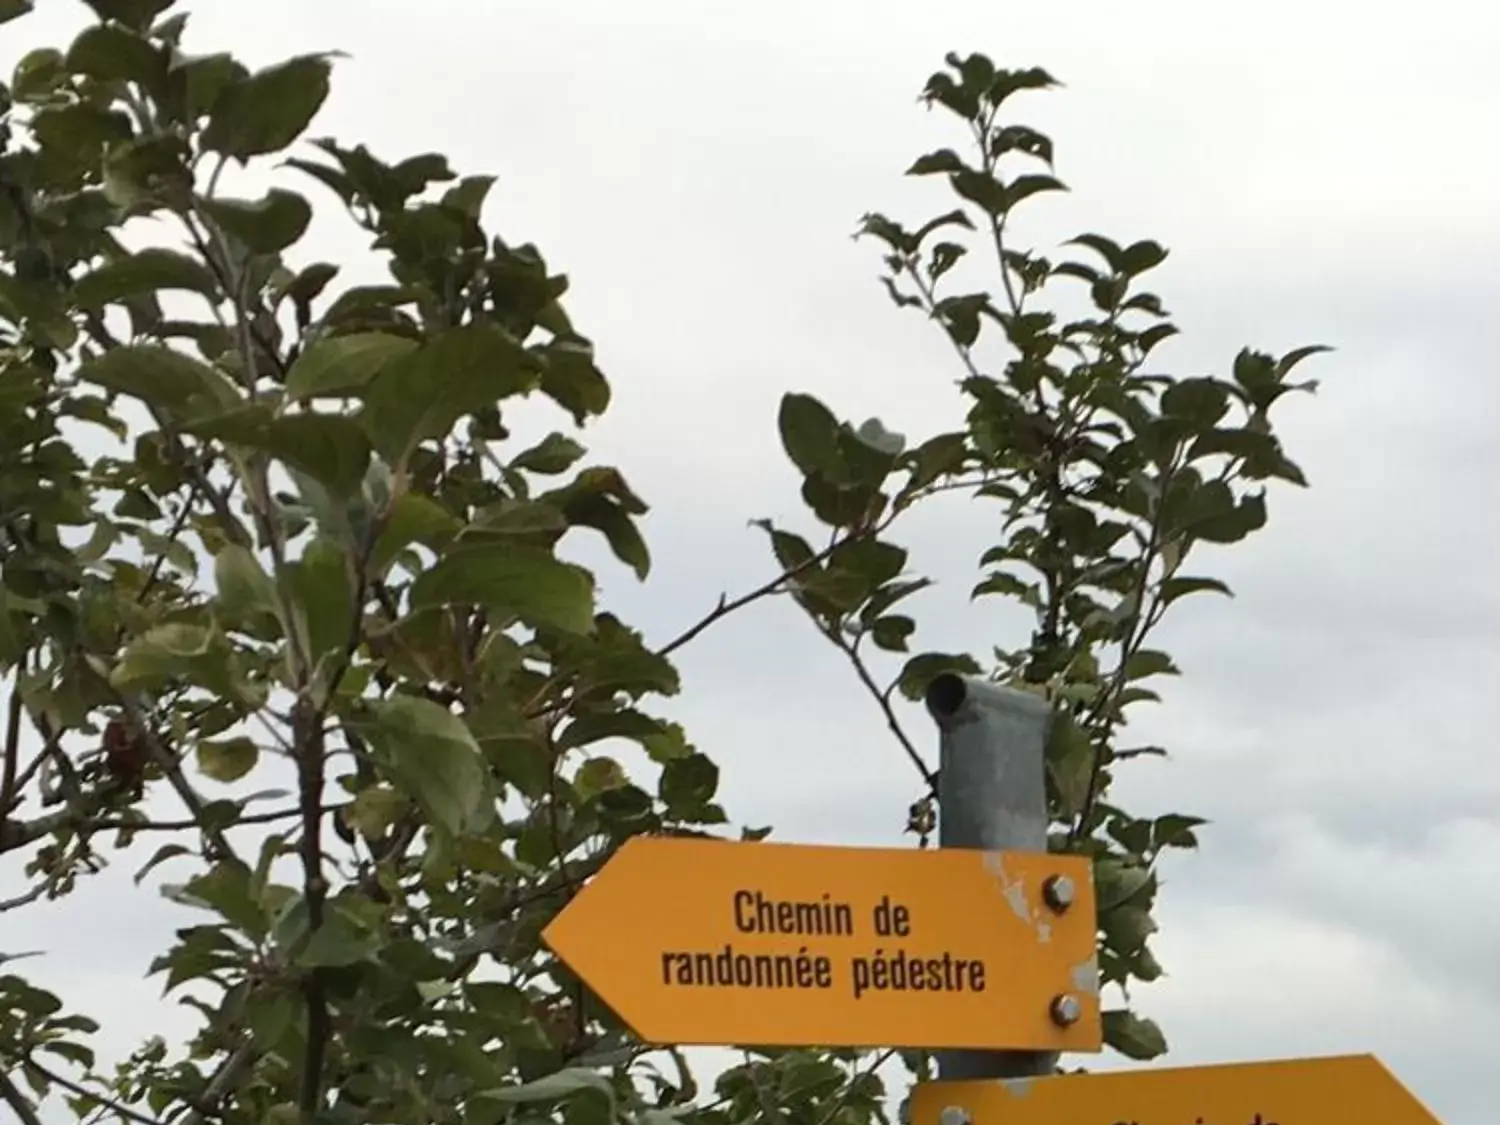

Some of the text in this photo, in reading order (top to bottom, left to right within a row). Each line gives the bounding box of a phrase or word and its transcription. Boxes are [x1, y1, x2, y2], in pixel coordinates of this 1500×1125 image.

[733, 889, 911, 938] Chemin de
[661, 944, 986, 1000] randonnée pédestre
